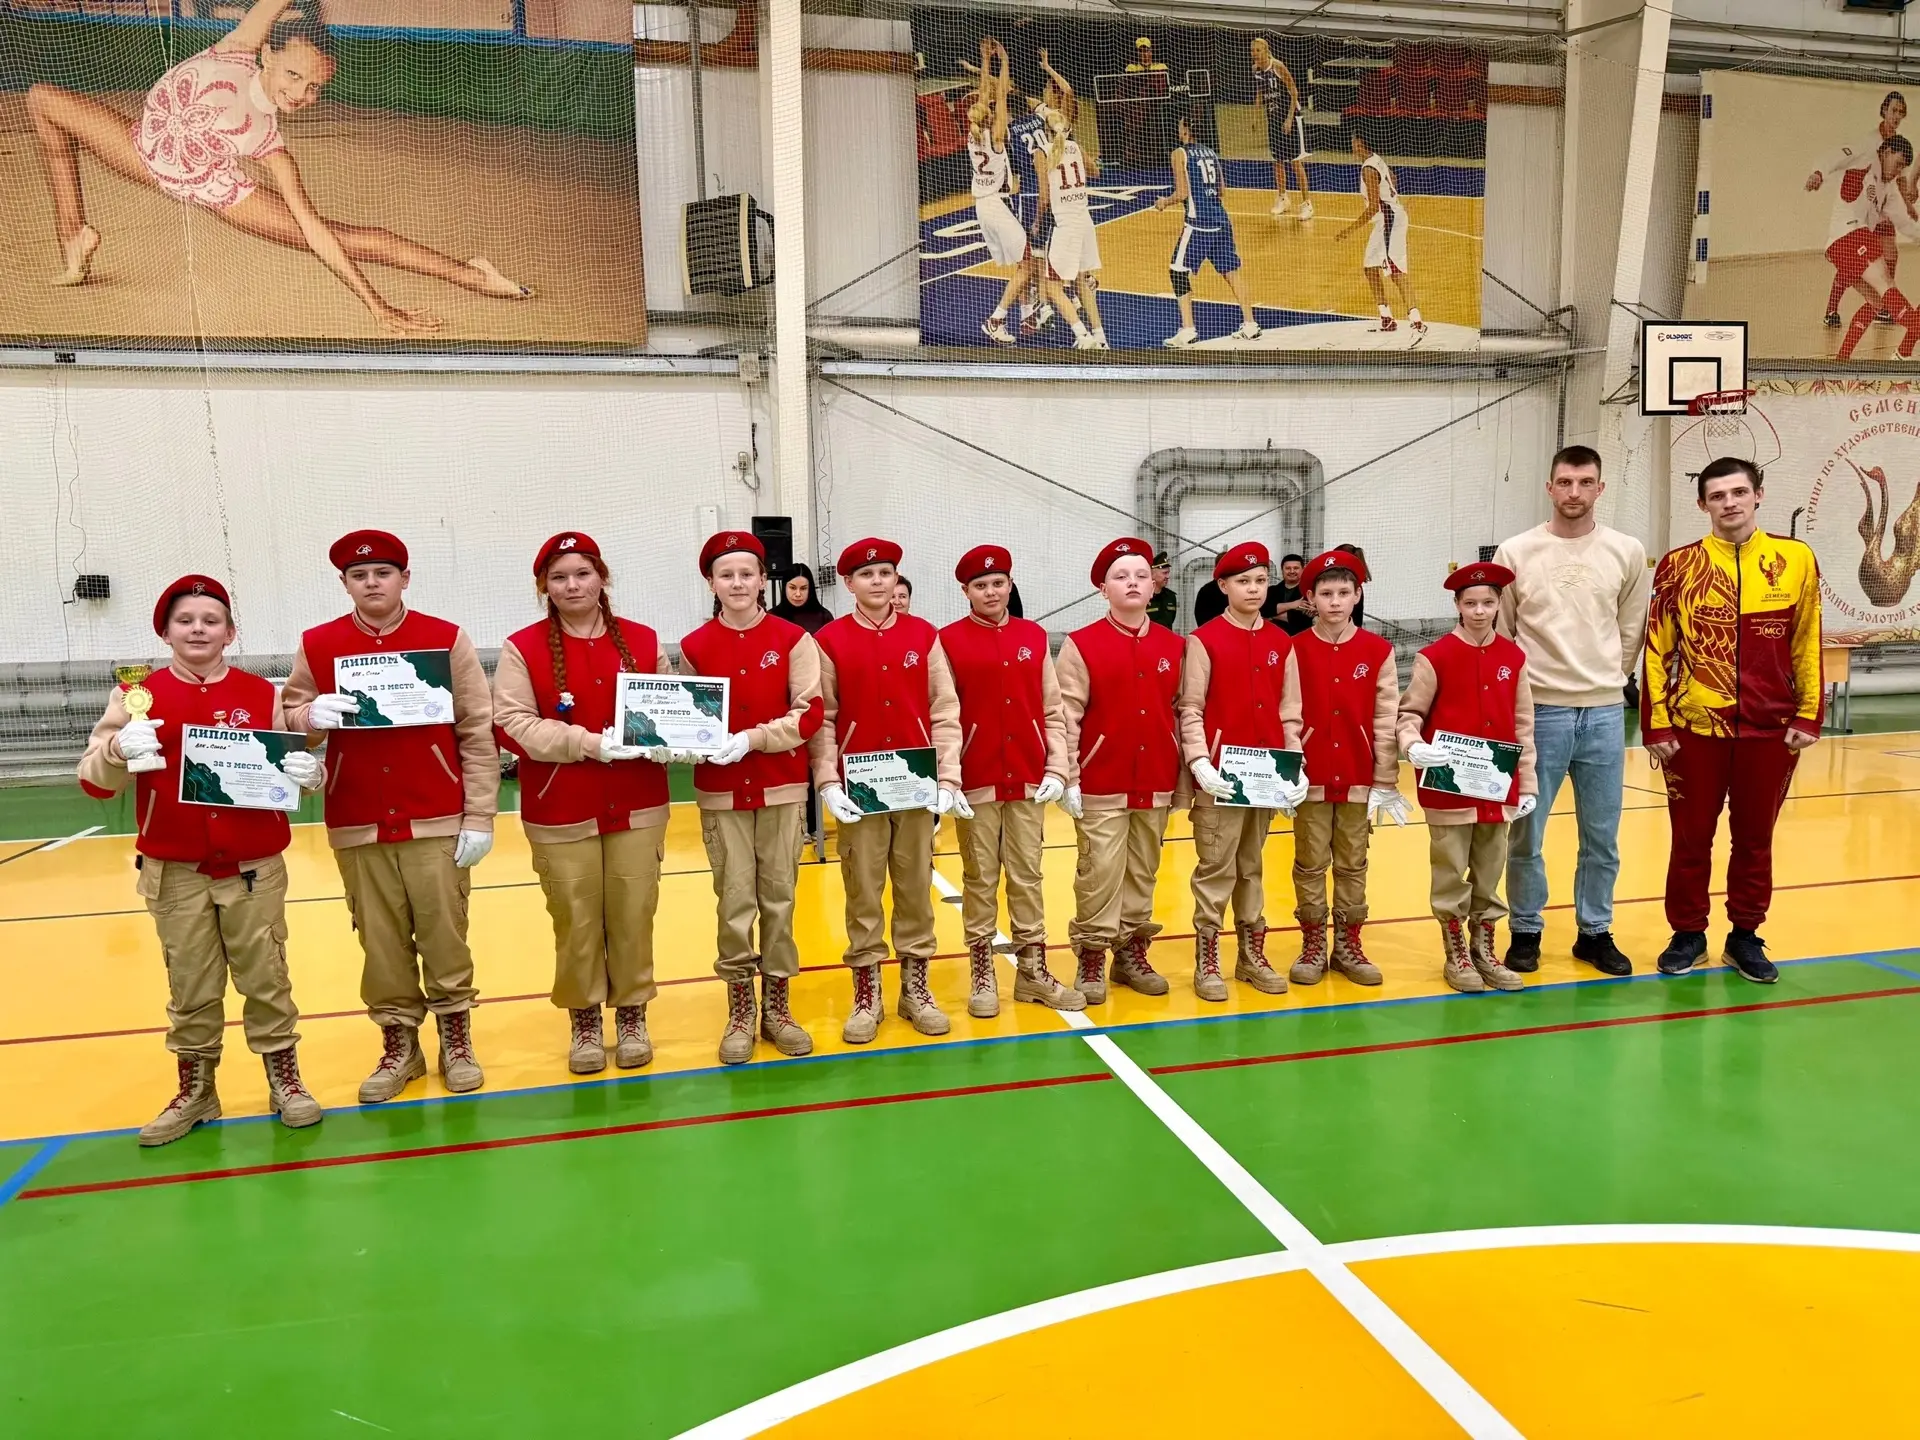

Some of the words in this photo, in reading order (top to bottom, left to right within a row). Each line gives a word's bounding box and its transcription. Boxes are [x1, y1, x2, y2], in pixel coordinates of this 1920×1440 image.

[974, 151, 994, 175] 2
[1057, 161, 1084, 189] 11
[1196, 159, 1216, 183] 15
[1850, 398, 1920, 423] СЕМЕН
[1806, 478, 1823, 533] ТУРНИР
[1821, 459, 1835, 476] ПО
[1857, 609, 1906, 624] ЗОЛОТОЙ
[340, 655, 399, 669] ДИПЛОМ
[628, 681, 680, 692] ДИПЛОМ
[188, 728, 251, 742] ДИПЛОМ
[1438, 733, 1485, 748] ДИПЛОМ
[847, 752, 895, 765] ДИПЛОМ
[1225, 747, 1268, 758] ДИПЛОМ
